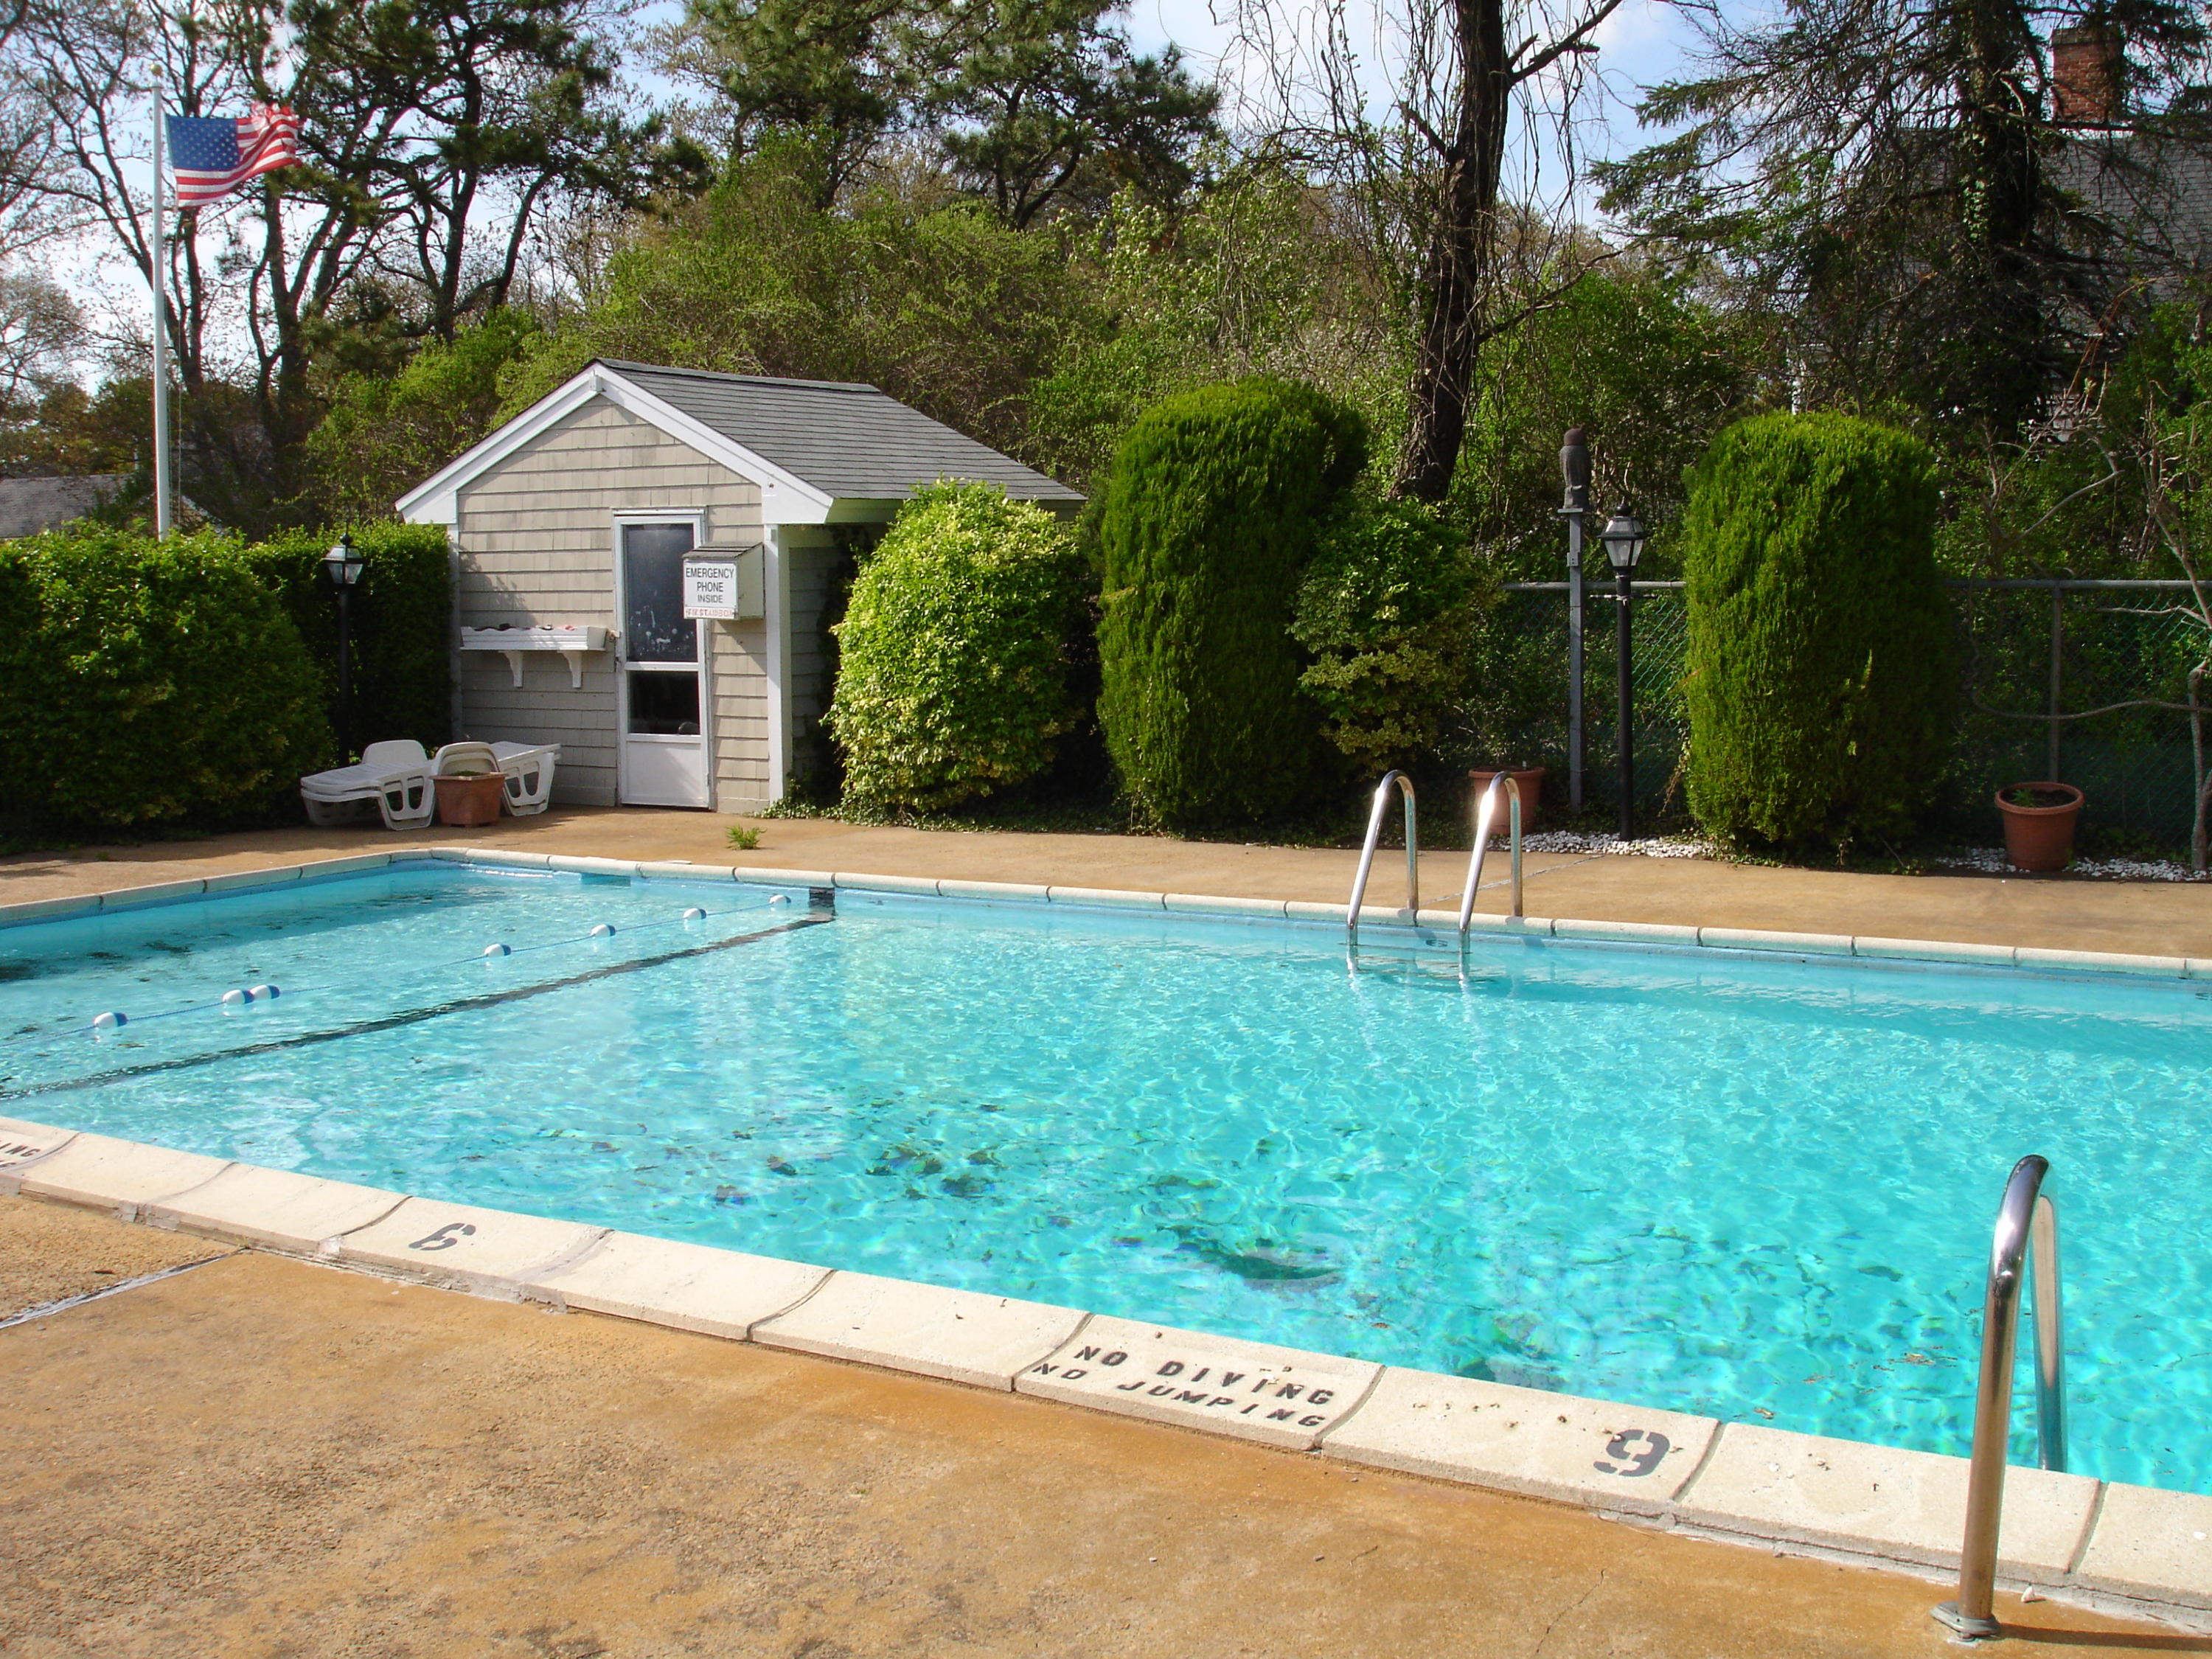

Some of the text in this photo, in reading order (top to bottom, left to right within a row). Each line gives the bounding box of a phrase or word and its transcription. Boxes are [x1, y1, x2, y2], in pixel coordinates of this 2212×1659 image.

[686, 568, 734, 578] EMERGENCY
[697, 582, 724, 592] PHONE
[698, 594, 723, 603] INSIDE
[408, 1222, 476, 1251] 6
[1074, 1346, 1334, 1405] NO DIVING
[1032, 1363, 1326, 1427] NO JUMPING
[1593, 1429, 1670, 1477] 9
